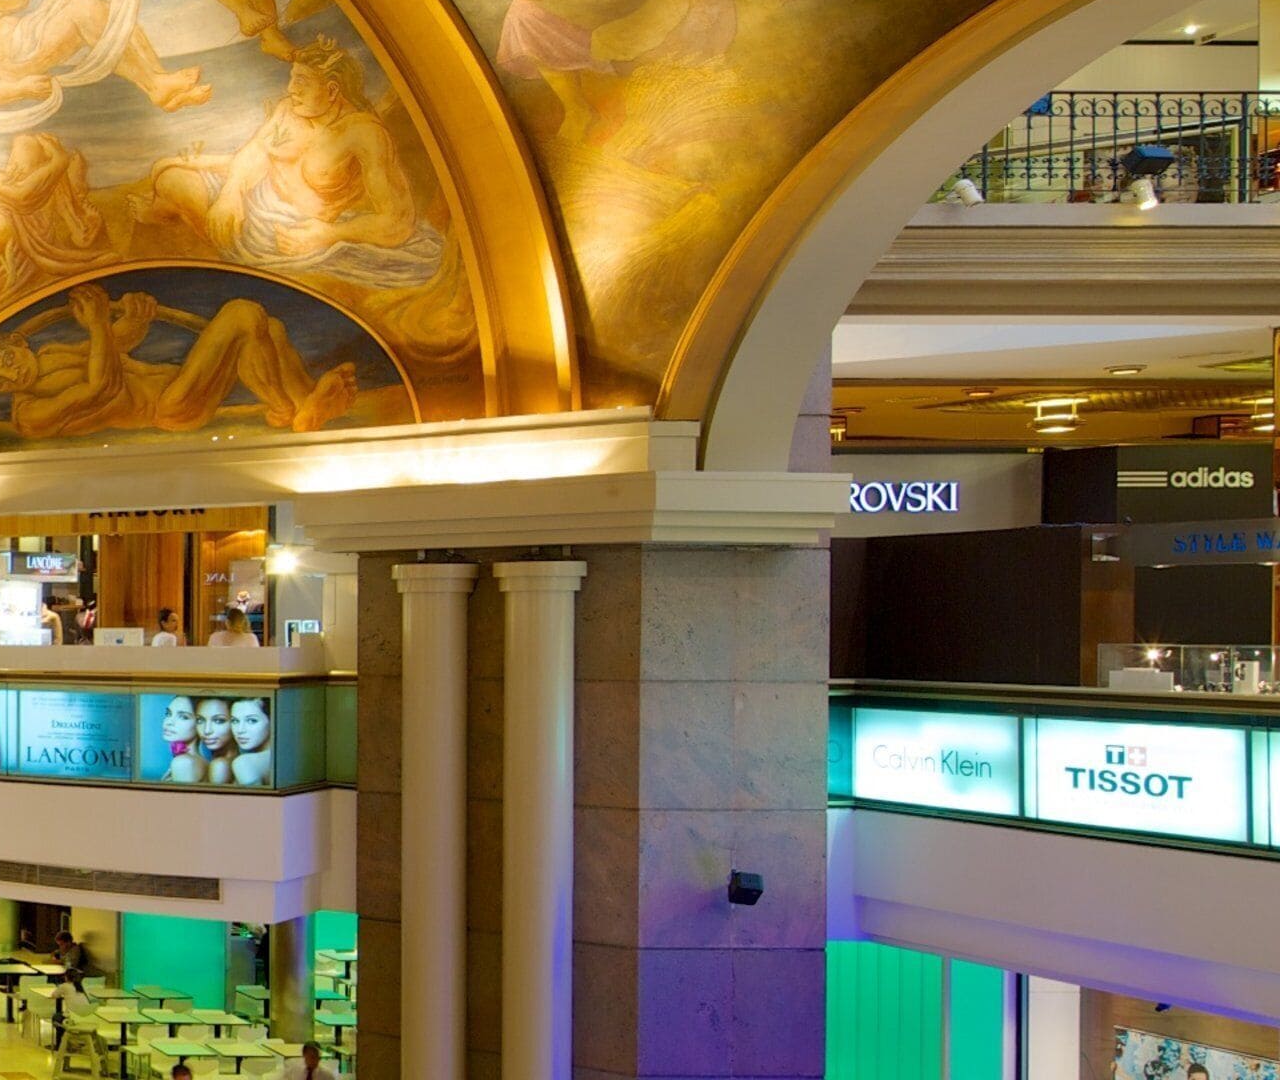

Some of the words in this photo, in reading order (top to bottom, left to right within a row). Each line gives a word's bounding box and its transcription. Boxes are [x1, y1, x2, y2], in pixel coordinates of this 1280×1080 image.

[1170, 467, 1255, 488] adidas
[849, 481, 959, 513] ROVSKI
[1172, 532, 1247, 554] STYLE
[1256, 530, 1280, 550] W
[872, 744, 936, 774] Calvin
[940, 749, 992, 778] Klein
[1064, 766, 1193, 799] TISSOT
